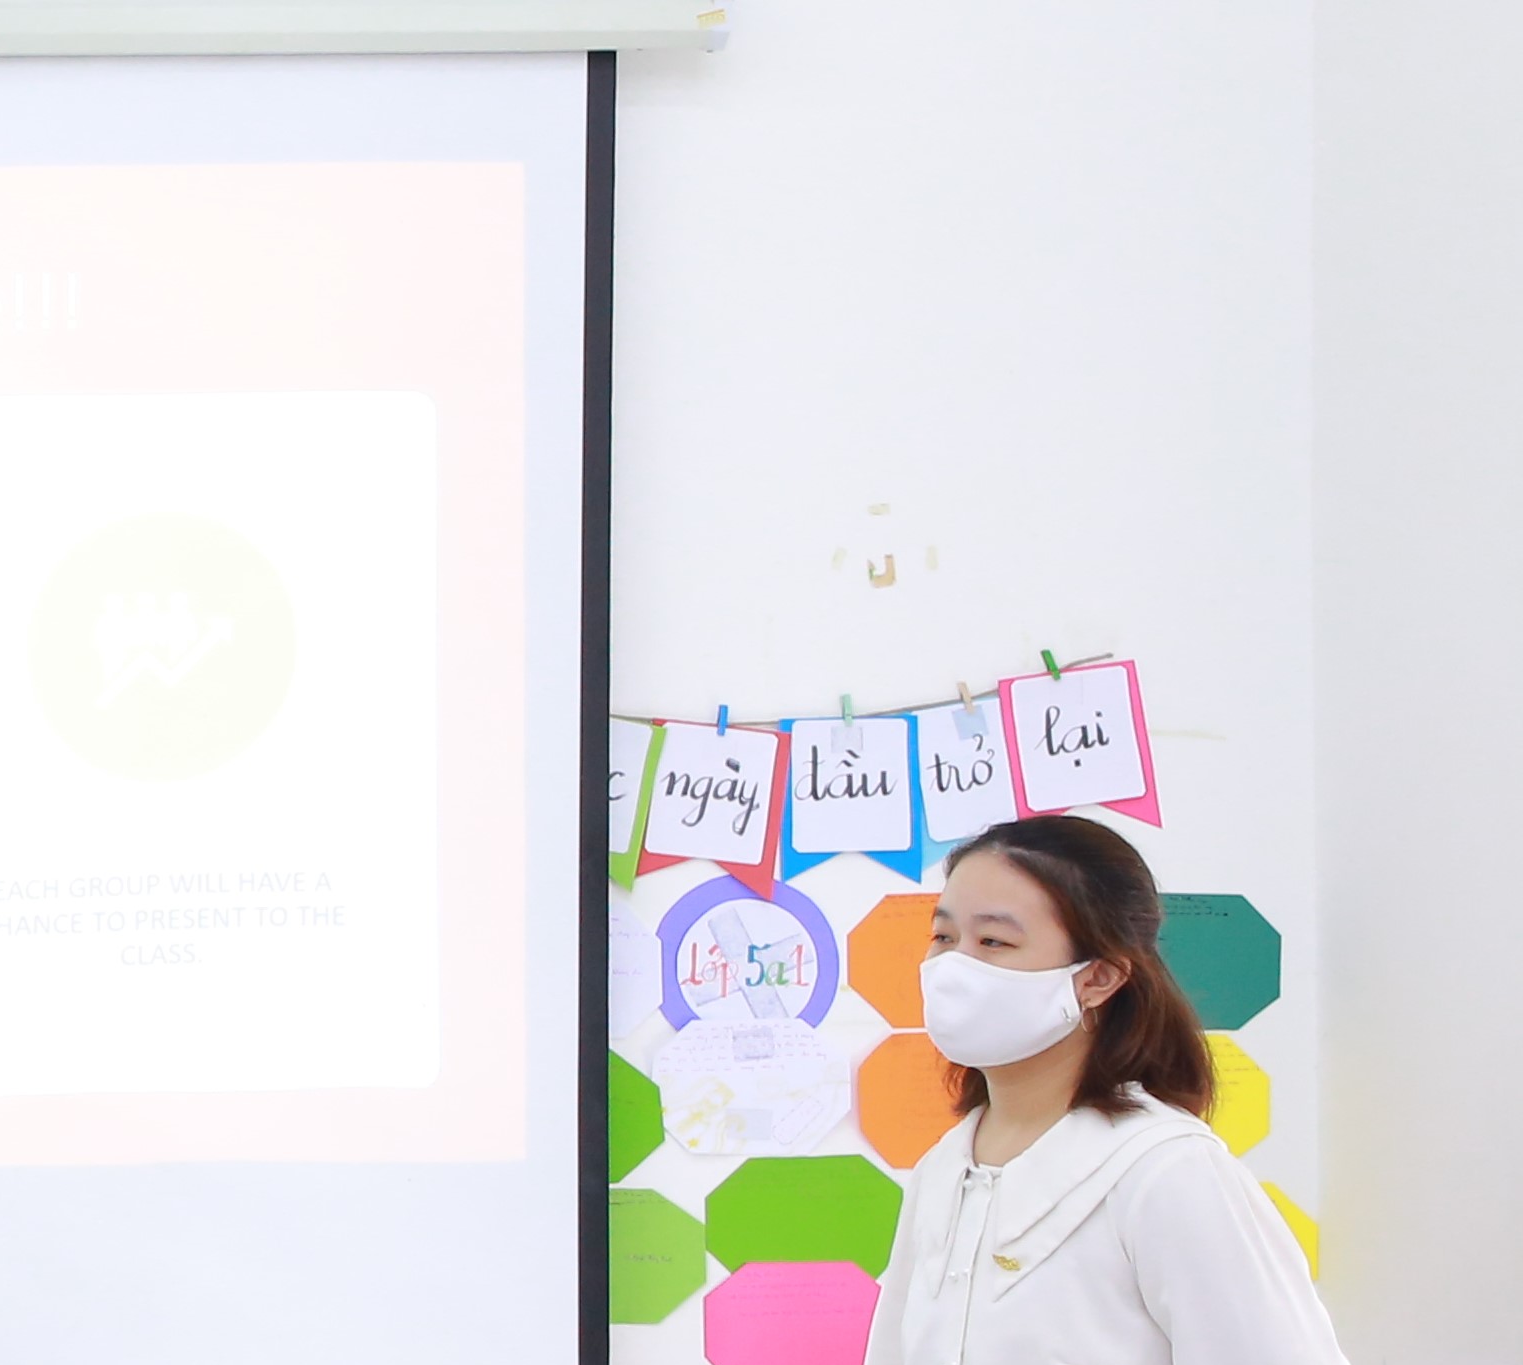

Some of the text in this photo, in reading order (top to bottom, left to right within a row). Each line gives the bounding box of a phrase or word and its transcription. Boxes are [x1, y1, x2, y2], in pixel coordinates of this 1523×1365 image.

[662, 757, 761, 836] ngày
[793, 745, 896, 801] đầu
[925, 733, 995, 794] trở
[1035, 705, 1111, 768] lại
[68, 874, 161, 899] GROUP
[169, 872, 230, 895] WILL
[238, 872, 305, 893] HAVE
[315, 871, 333, 892] A
[93, 911, 125, 932] TO
[135, 906, 247, 931] PRESENT
[254, 906, 289, 928] TO
[297, 905, 346, 927] THE
[120, 943, 203, 967] CLASS.
